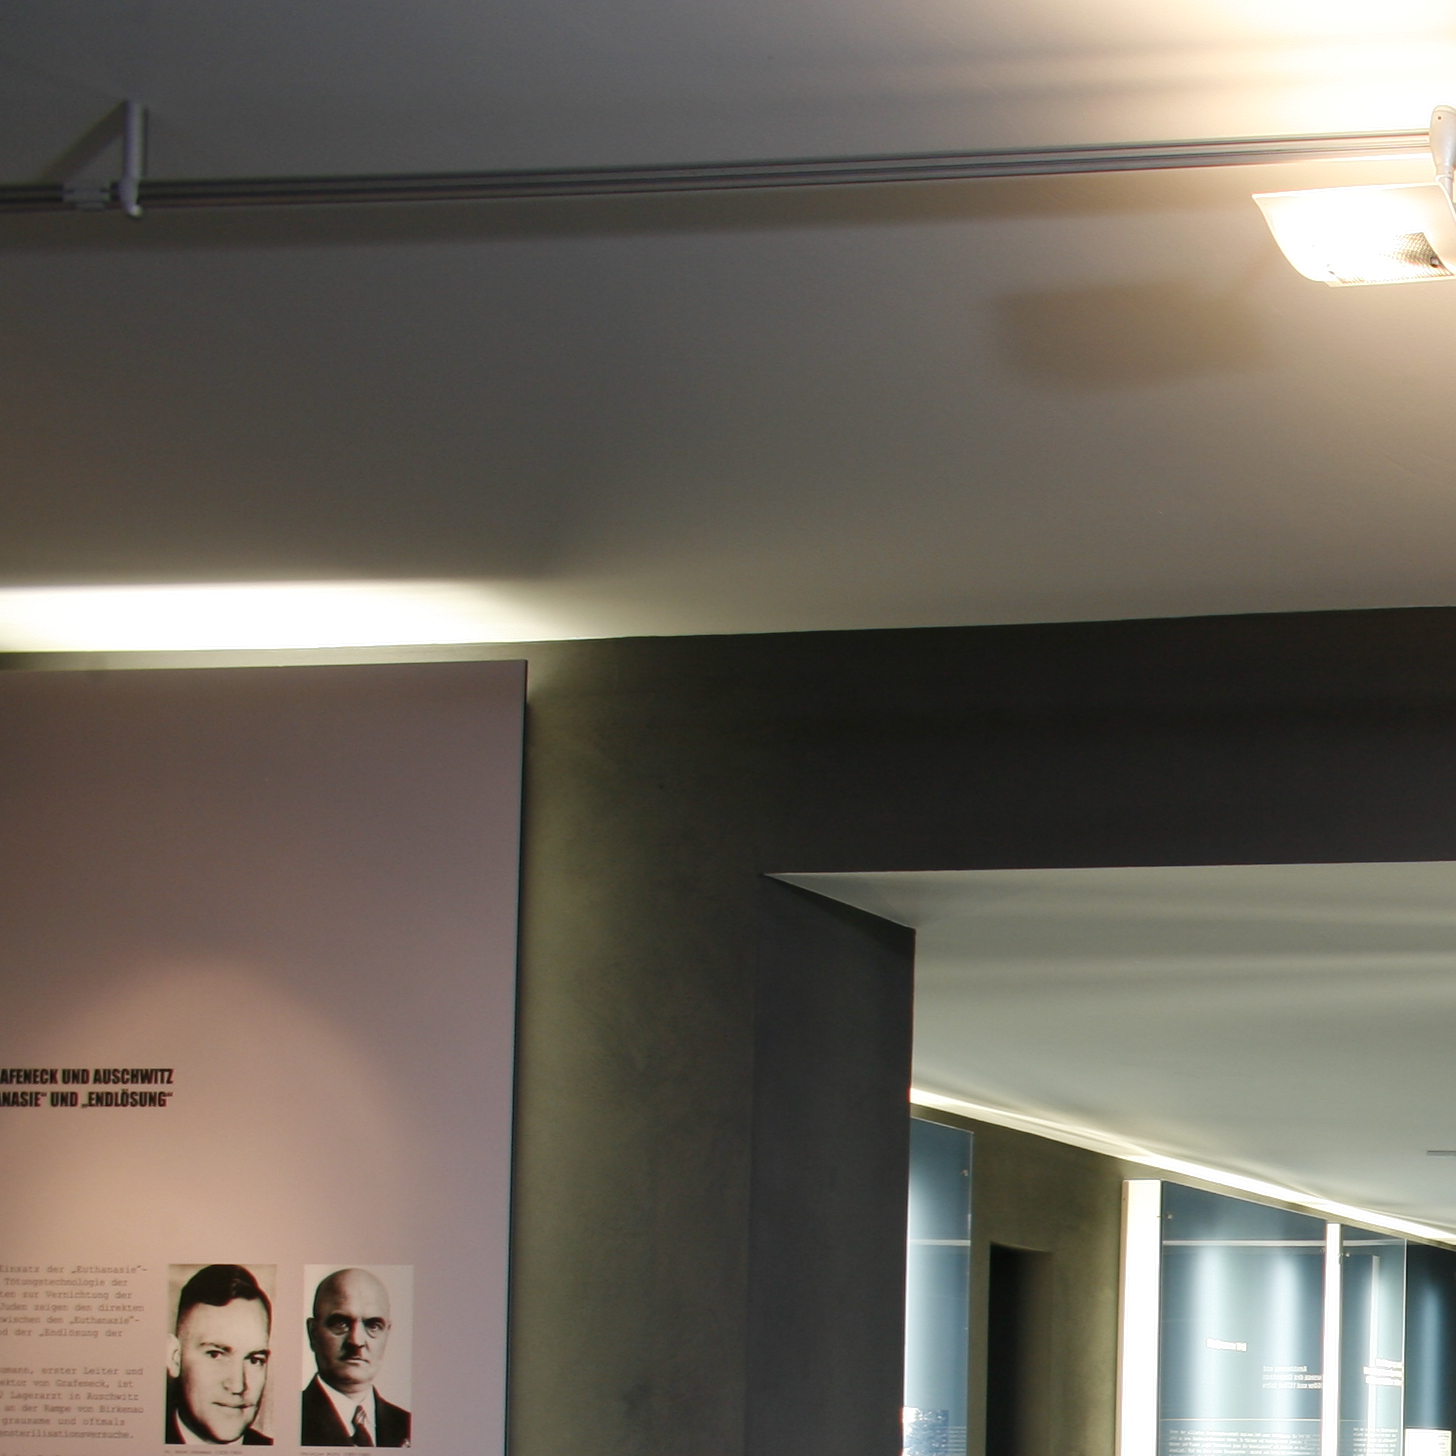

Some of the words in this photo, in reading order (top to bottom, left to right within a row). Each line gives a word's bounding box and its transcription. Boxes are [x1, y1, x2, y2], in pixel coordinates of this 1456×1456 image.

[62, 1068, 90, 1085] UND
[93, 1068, 175, 1085] AUSCHWITZ
[0, 1091, 47, 1108] NASIE“
[51, 1091, 79, 1108] UND
